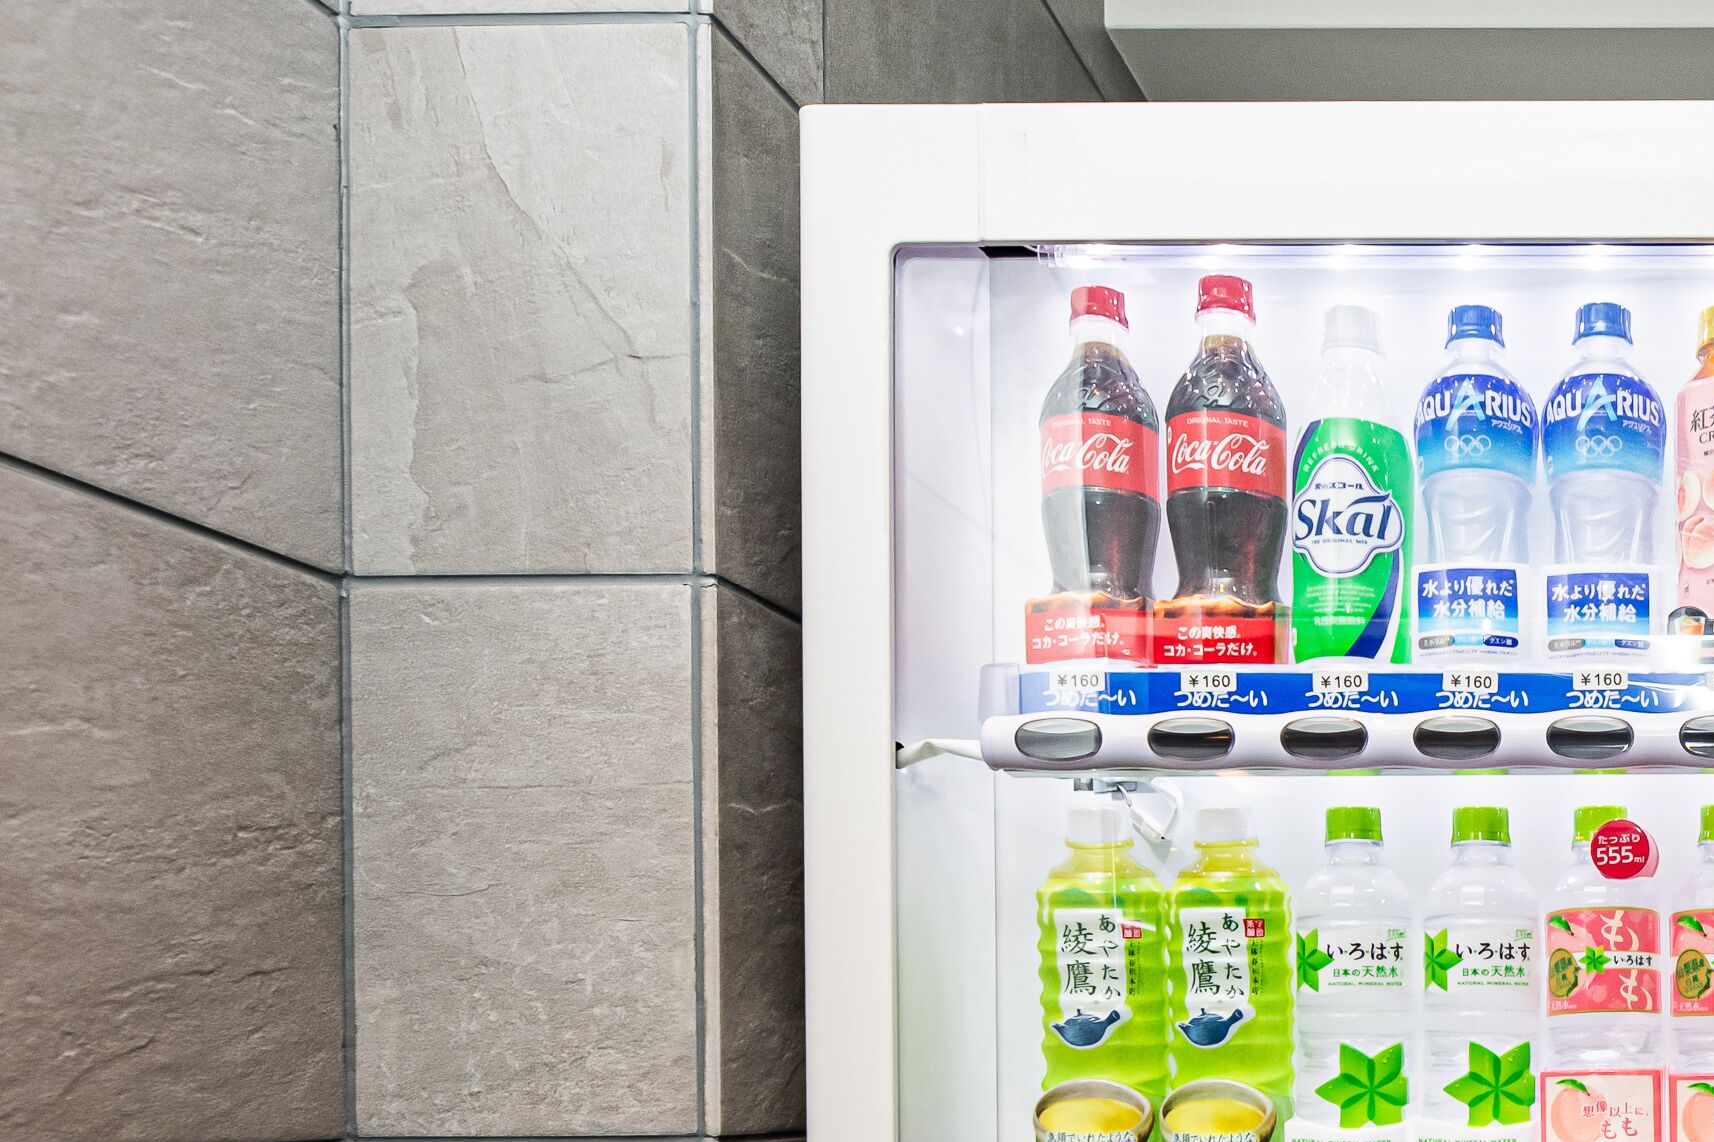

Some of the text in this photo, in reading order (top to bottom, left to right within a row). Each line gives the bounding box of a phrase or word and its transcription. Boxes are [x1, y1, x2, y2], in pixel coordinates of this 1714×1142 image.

[1418, 377, 1533, 431] AQUARIUS
[1547, 377, 1662, 431] AQUARIUS
[1042, 433, 1134, 478] Coca-Cola
[1171, 433, 1270, 474] Coca-Cola
[1057, 674, 1099, 687] ¥160
[1189, 675, 1230, 687] ¥160
[1321, 675, 1362, 688] ¥160
[1451, 675, 1492, 689] ¥160
[1580, 673, 1622, 686] ¥160
[1597, 834, 1640, 844] たっぷり
[1061, 921, 1098, 996] 綾鷹
[1186, 921, 1221, 996] 綾鷹
[1333, 965, 1399, 977] 日本の天然水
[1463, 965, 1525, 977] 日本の天然水
[1601, 1118, 1638, 1139] もも
